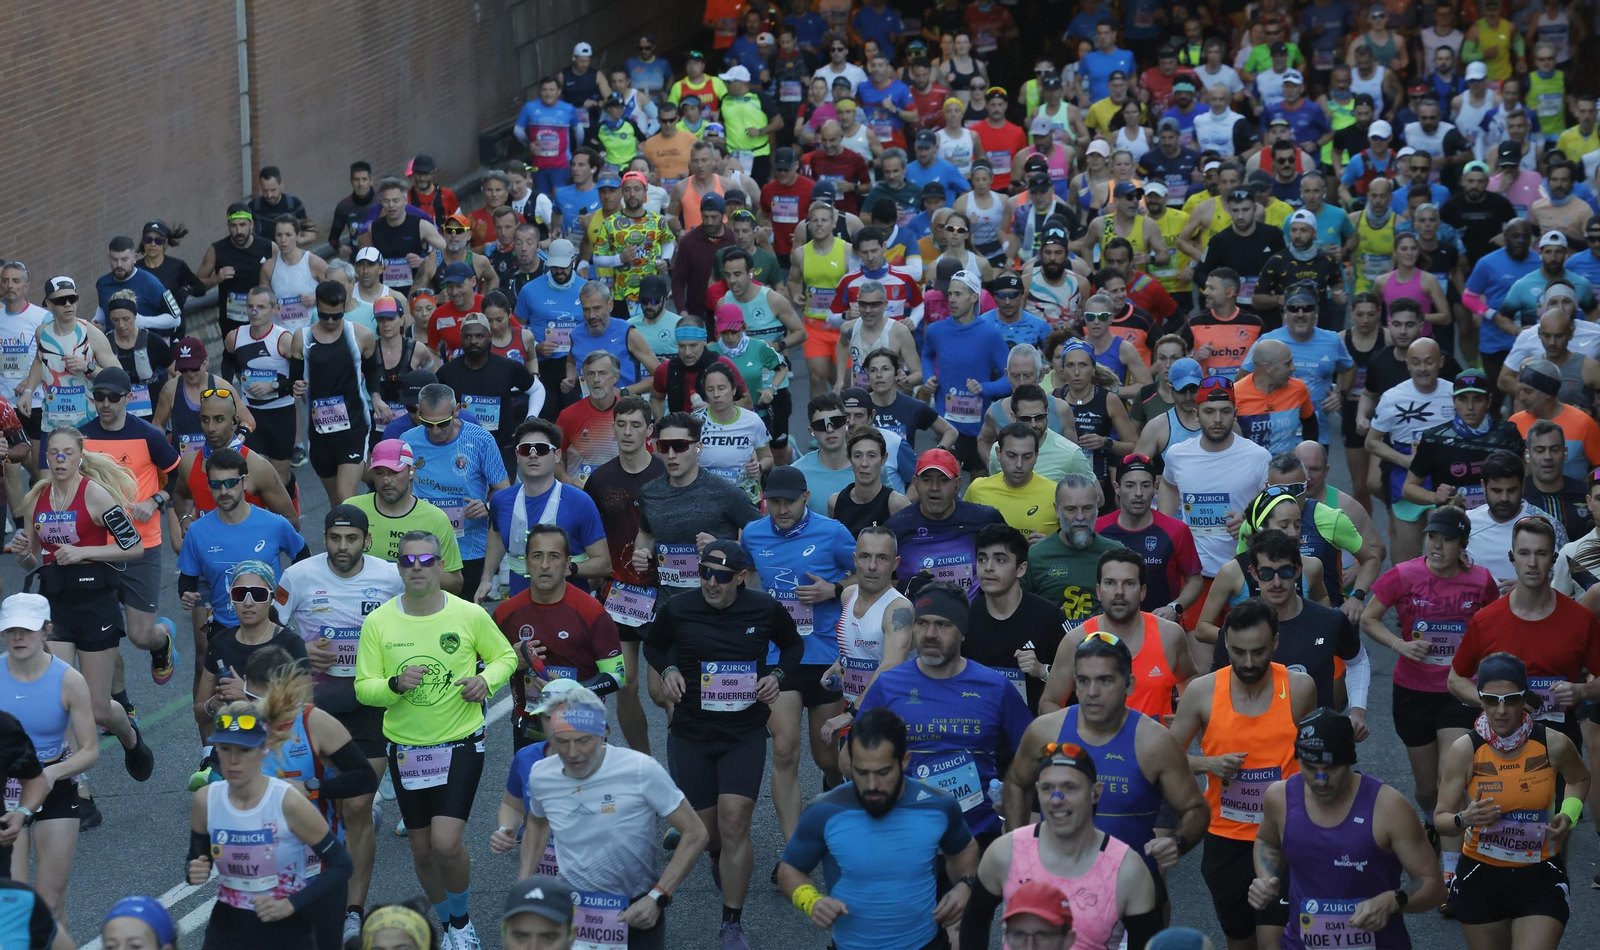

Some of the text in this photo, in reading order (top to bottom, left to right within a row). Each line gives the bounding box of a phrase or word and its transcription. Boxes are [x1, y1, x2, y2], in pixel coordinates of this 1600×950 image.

[951, 405, 975, 415] RUBEN
[1251, 417, 1291, 432] ESTO NO
[432, 482, 464, 493] Aguas
[1190, 516, 1227, 526] NICOLAS
[937, 556, 966, 566] ZURICH
[938, 570, 955, 578] 8836
[627, 584, 654, 597] ZURICH
[604, 601, 650, 620] PAWEL SKIBA
[1431, 624, 1462, 632] ZURICH
[1431, 636, 1448, 644] 9802
[338, 644, 355, 652] 9426
[721, 664, 751, 672] ZURICH
[849, 659, 874, 669] ZURICH
[721, 678, 738, 686] 9569
[851, 673, 863, 683] 8512
[701, 691, 758, 700] J M GUERRERO
[905, 723, 982, 735] FUENTES
[416, 753, 433, 763] 8726
[932, 754, 967, 773] ZURICH
[421, 767, 440, 777] MARÍA
[1241, 770, 1274, 780] ZURICH
[938, 776, 958, 788] 5212
[1097, 774, 1129, 783] DEPORTIVO
[947, 783, 973, 799] MA
[1241, 787, 1260, 797] 8455
[1220, 796, 1259, 811] GONCALO
[1501, 826, 1525, 837] 10126
[230, 833, 266, 843] ZURICH
[1478, 832, 1543, 850] FRANCESCA
[231, 852, 251, 861] 9956
[227, 863, 261, 877] MILLY
[584, 896, 621, 907] ZURICH
[584, 914, 604, 925] 8959
[1325, 921, 1346, 931] 8341
[1303, 931, 1372, 947] NOE Y LEO
